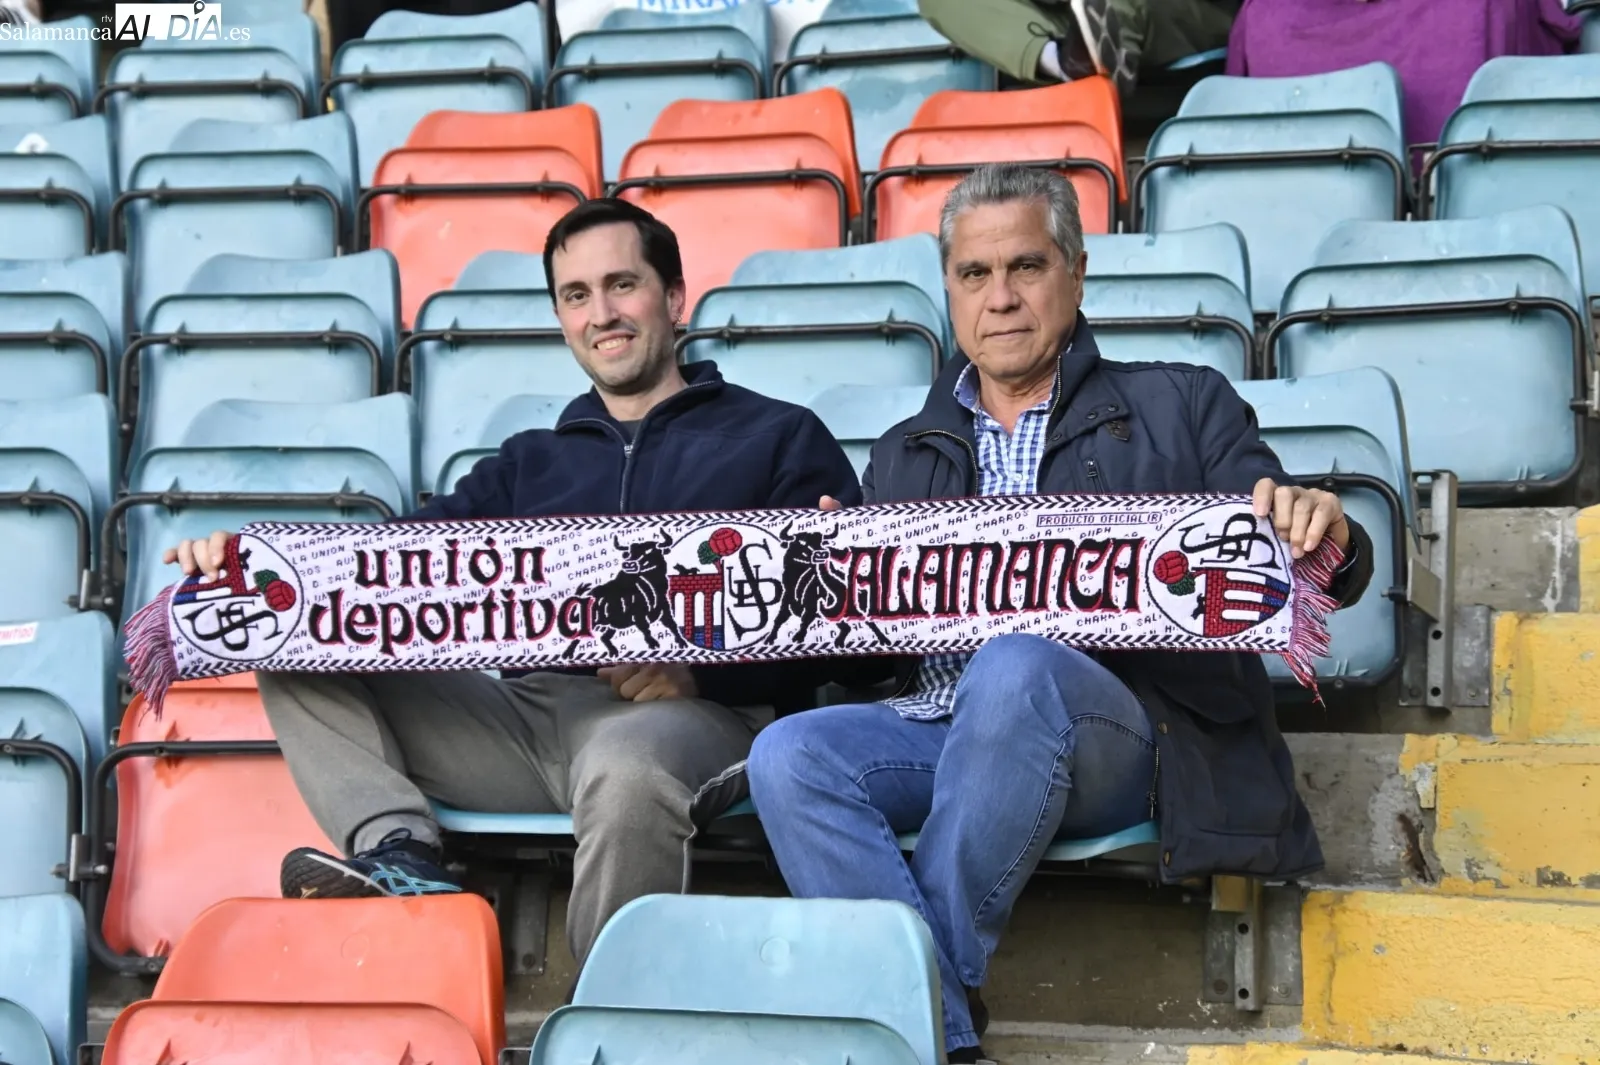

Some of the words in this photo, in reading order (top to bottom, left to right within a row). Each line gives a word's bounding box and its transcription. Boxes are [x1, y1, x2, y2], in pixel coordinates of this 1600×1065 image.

[1038, 515, 1096, 526] PRODUCTO
[1100, 514, 1144, 525] OFICIAL
[818, 537, 1146, 623] SALAMANCA
[308, 587, 596, 659] deportiva
